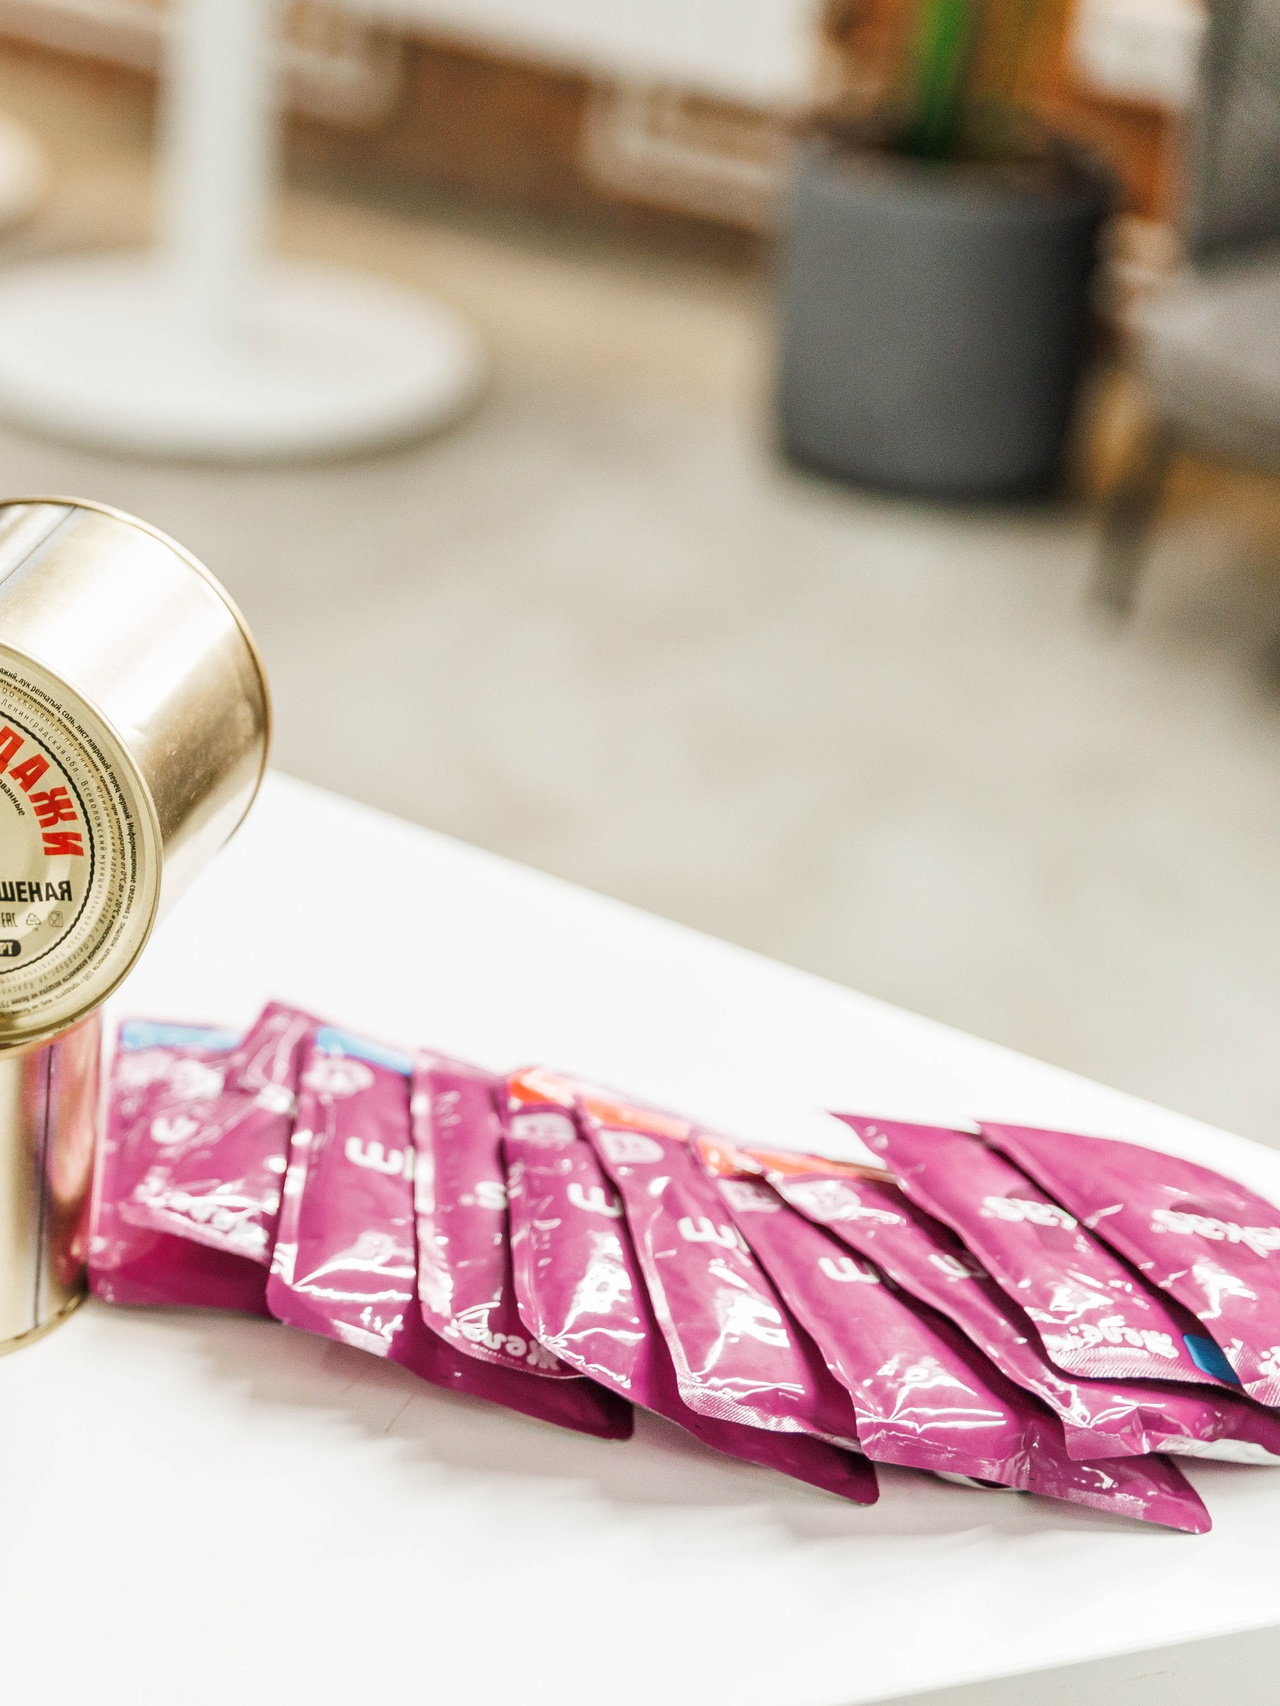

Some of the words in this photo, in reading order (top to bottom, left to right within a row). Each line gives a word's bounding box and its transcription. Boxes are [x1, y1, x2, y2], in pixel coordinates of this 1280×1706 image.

[17, 677, 31, 689] лук
[12, 684, 57, 719] изготовления.
[30, 683, 65, 713] репчатый,
[54, 716, 80, 742] Условия
[59, 709, 78, 728] соль,
[73, 723, 89, 739] лист
[76, 740, 102, 775] хранения:
[84, 736, 114, 773] лавровый,
[0, 697, 68, 757] Ленинградская
[78, 779, 108, 852] Всеволожский
[98, 774, 115, 802] хранить
[105, 771, 122, 793] перец
[109, 802, 119, 816] при
[115, 792, 133, 821] черный.
[113, 817, 126, 861] температуре
[124, 822, 139, 884] Информационные
[122, 883, 135, 915] сведения
